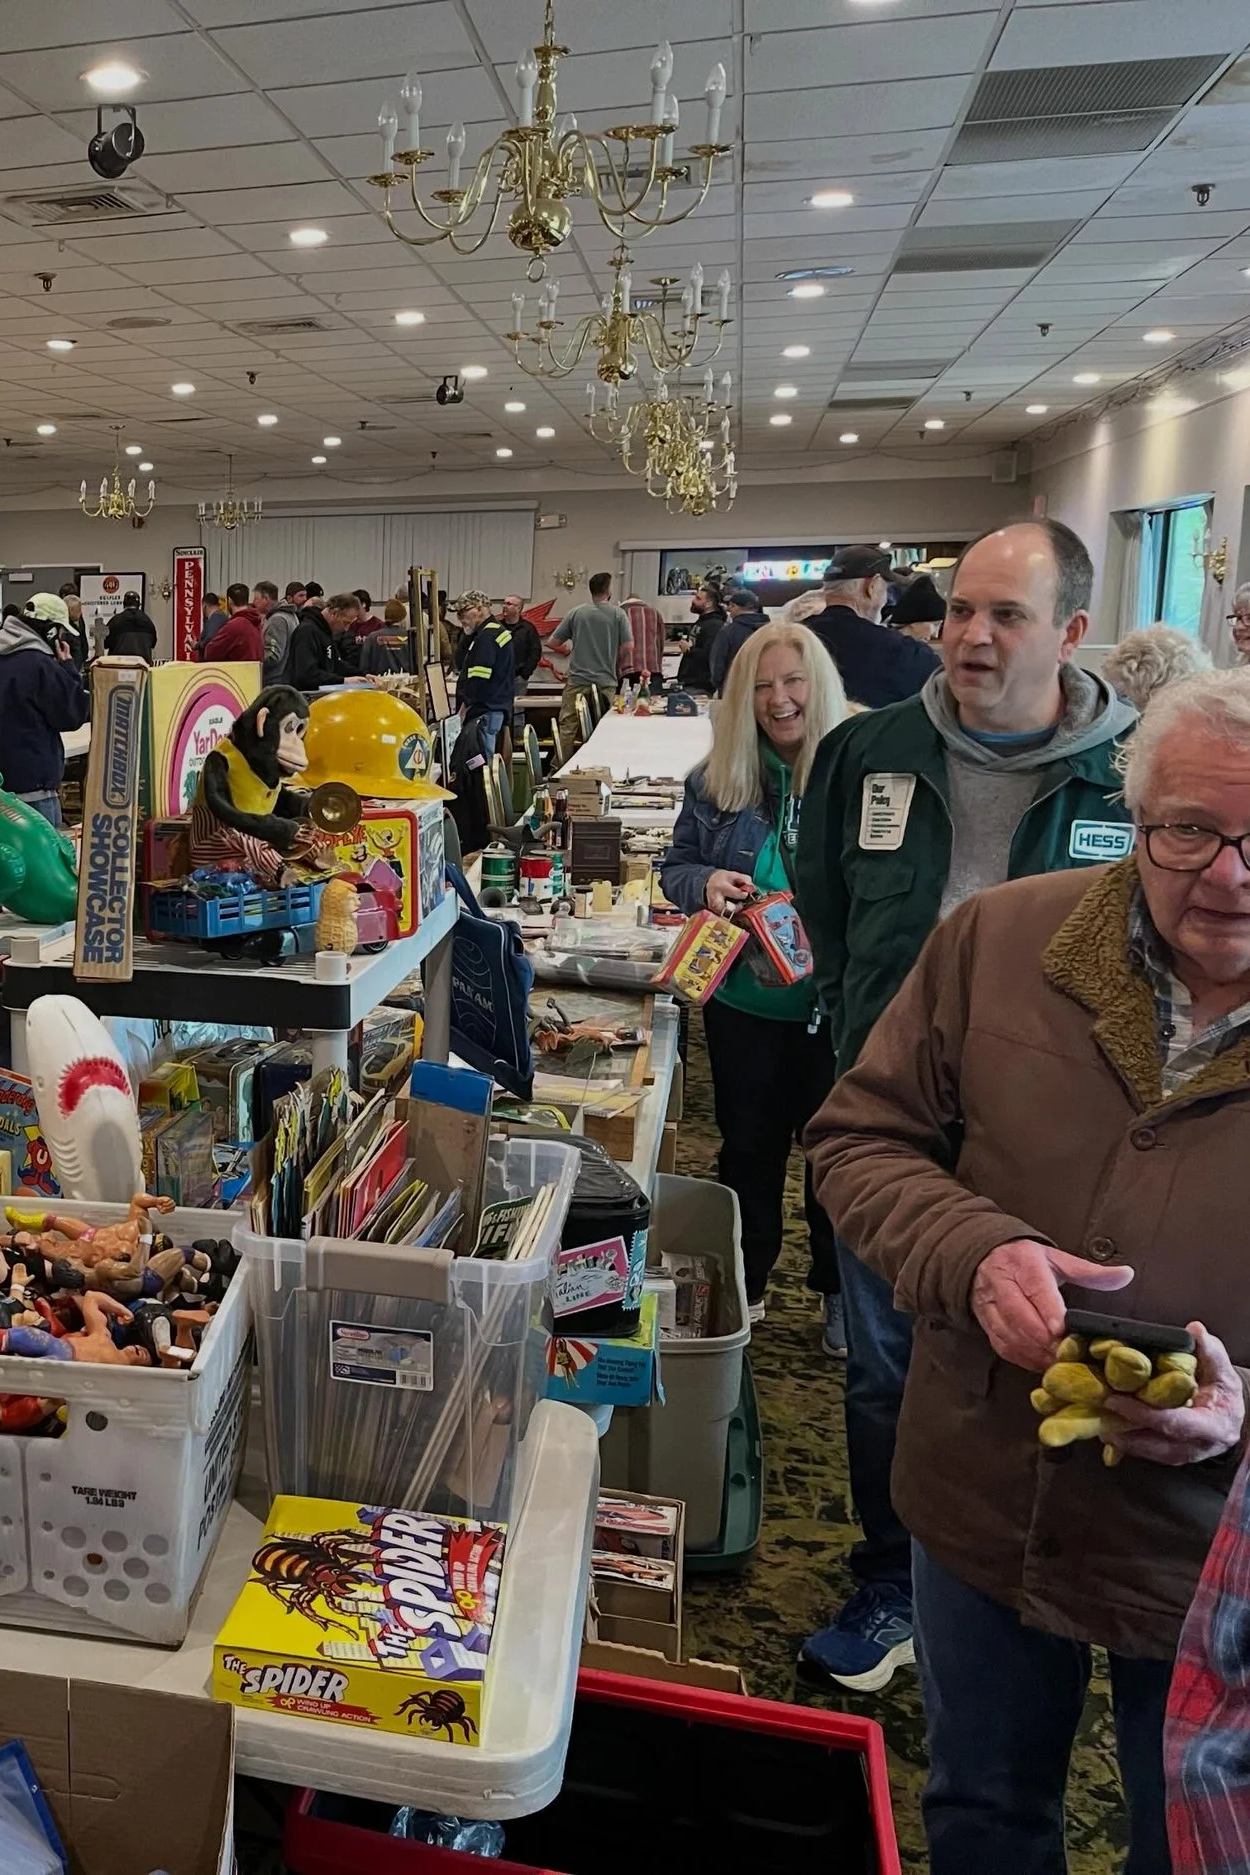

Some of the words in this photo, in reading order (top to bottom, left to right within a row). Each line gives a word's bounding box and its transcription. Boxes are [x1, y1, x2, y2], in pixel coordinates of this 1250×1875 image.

[184, 561, 196, 661] PENNSYLVANI
[1078, 832, 1127, 849] HESS
[83, 813, 111, 964] SHOWCASE
[104, 815, 131, 965] COLLECTOR
[72, 1486, 96, 1496] TARE
[98, 1489, 137, 1500] WEIGHT
[378, 1513, 464, 1641] SPIDER
[372, 1623, 417, 1659] THE
[224, 1655, 247, 1674] THE
[241, 1664, 350, 1703] SPIDER
[297, 1699, 319, 1708] WIND
[297, 1705, 339, 1718] CRAWLING
[341, 1713, 371, 1722] ACTION
